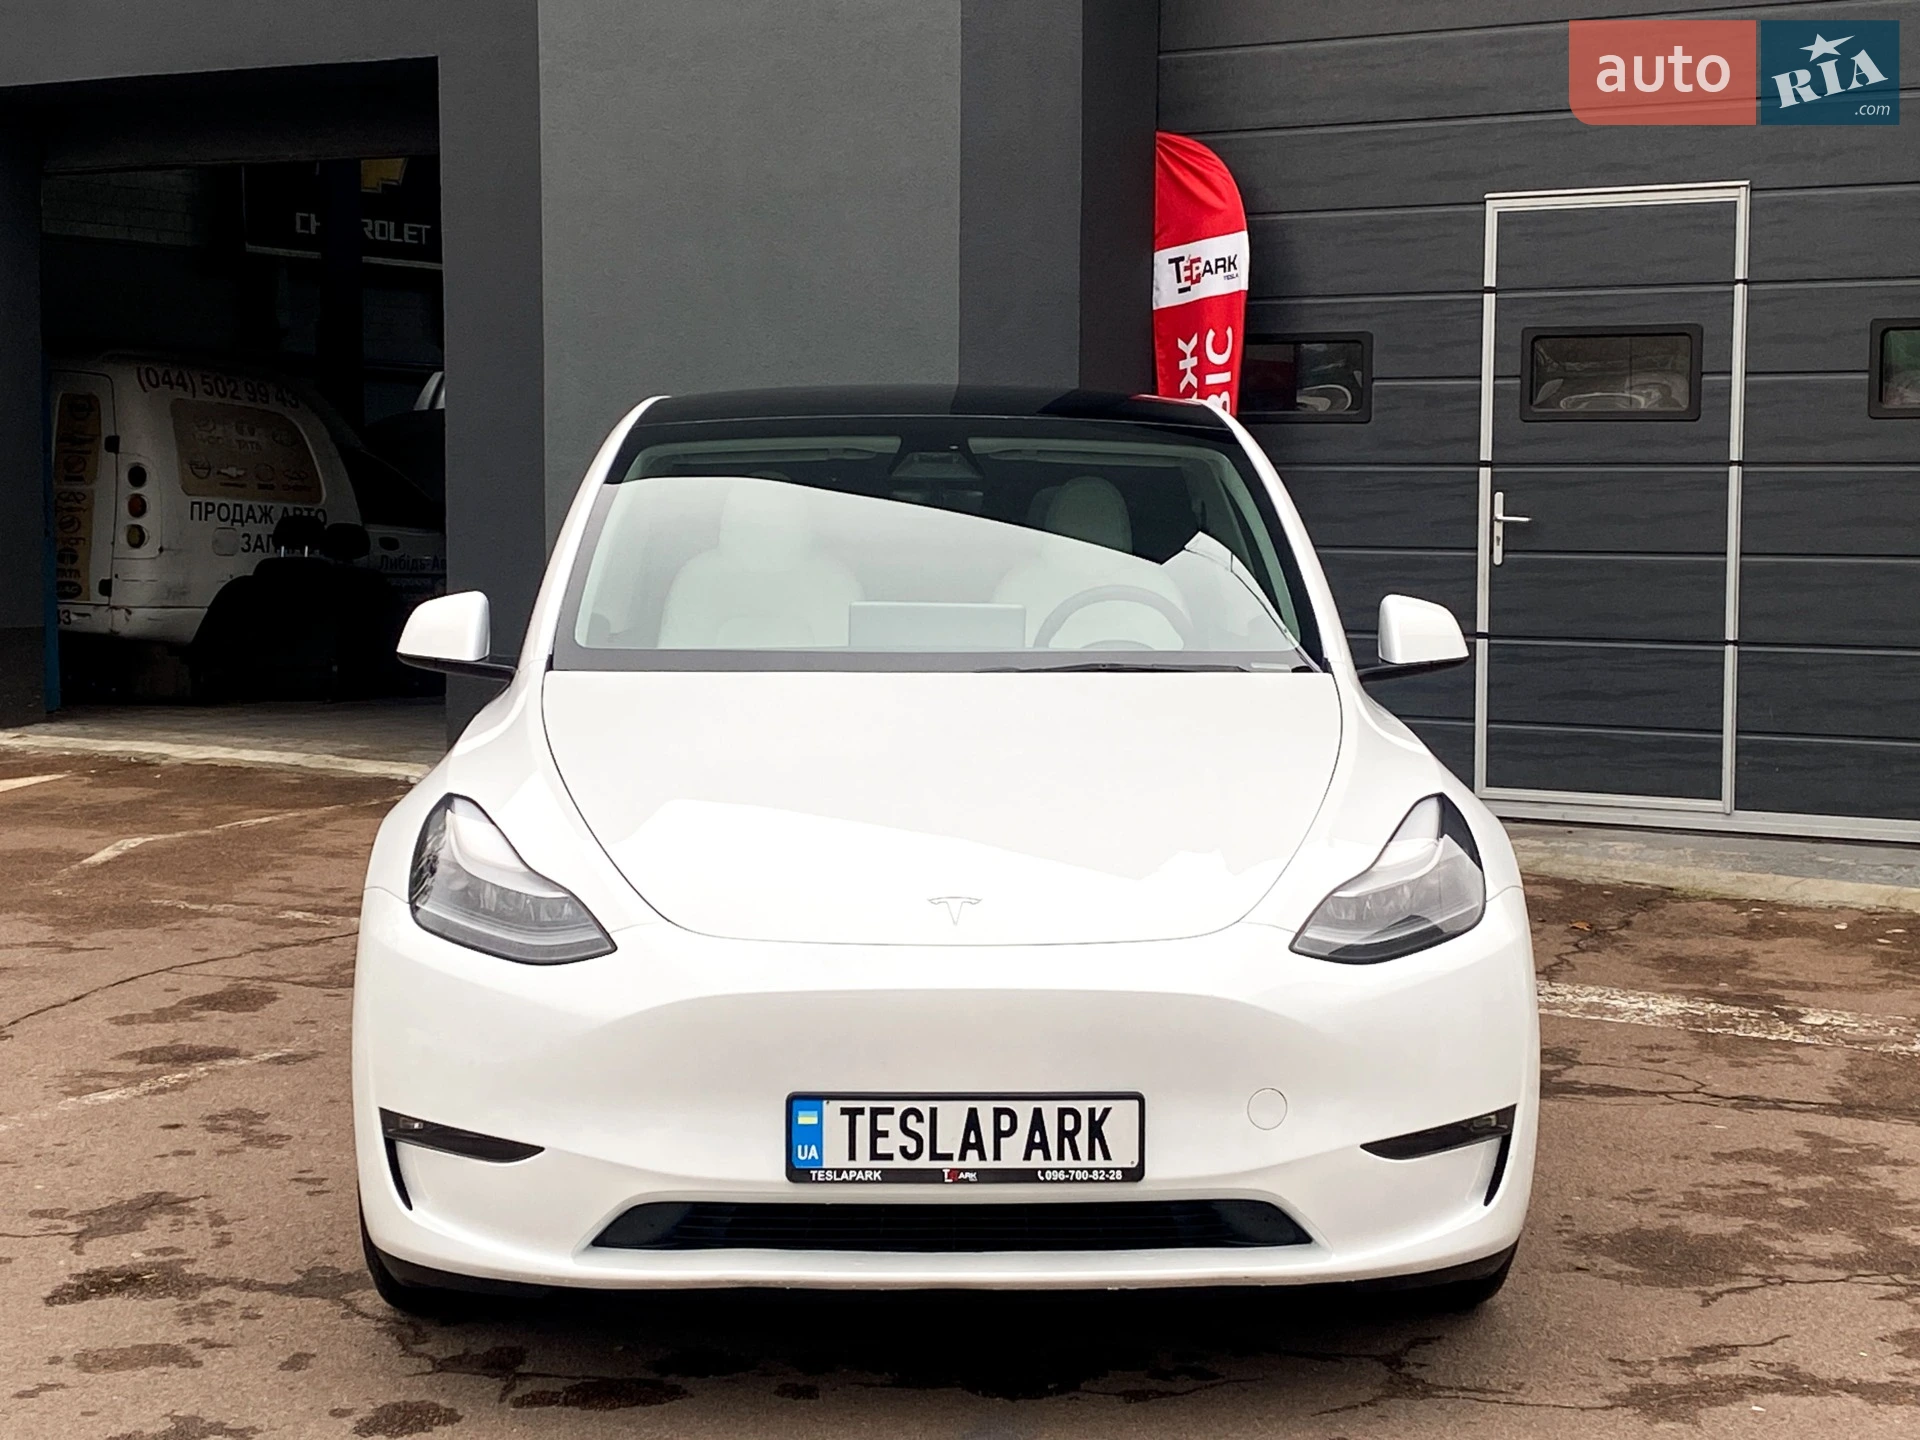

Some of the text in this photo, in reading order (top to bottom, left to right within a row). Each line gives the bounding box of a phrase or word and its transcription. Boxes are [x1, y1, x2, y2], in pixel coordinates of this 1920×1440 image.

[295, 212, 431, 245] CHROLET
[136, 366, 195, 399] (044)
[199, 373, 241, 401] 502
[243, 381, 269, 405] 99
[189, 501, 274, 527] ПРОДАЖ
[797, 1106, 1113, 1162] UA TESLAPARK
[810, 1169, 882, 1182] TESLAPARK
[1044, 1170, 1123, 1181] 096-700-82-28
